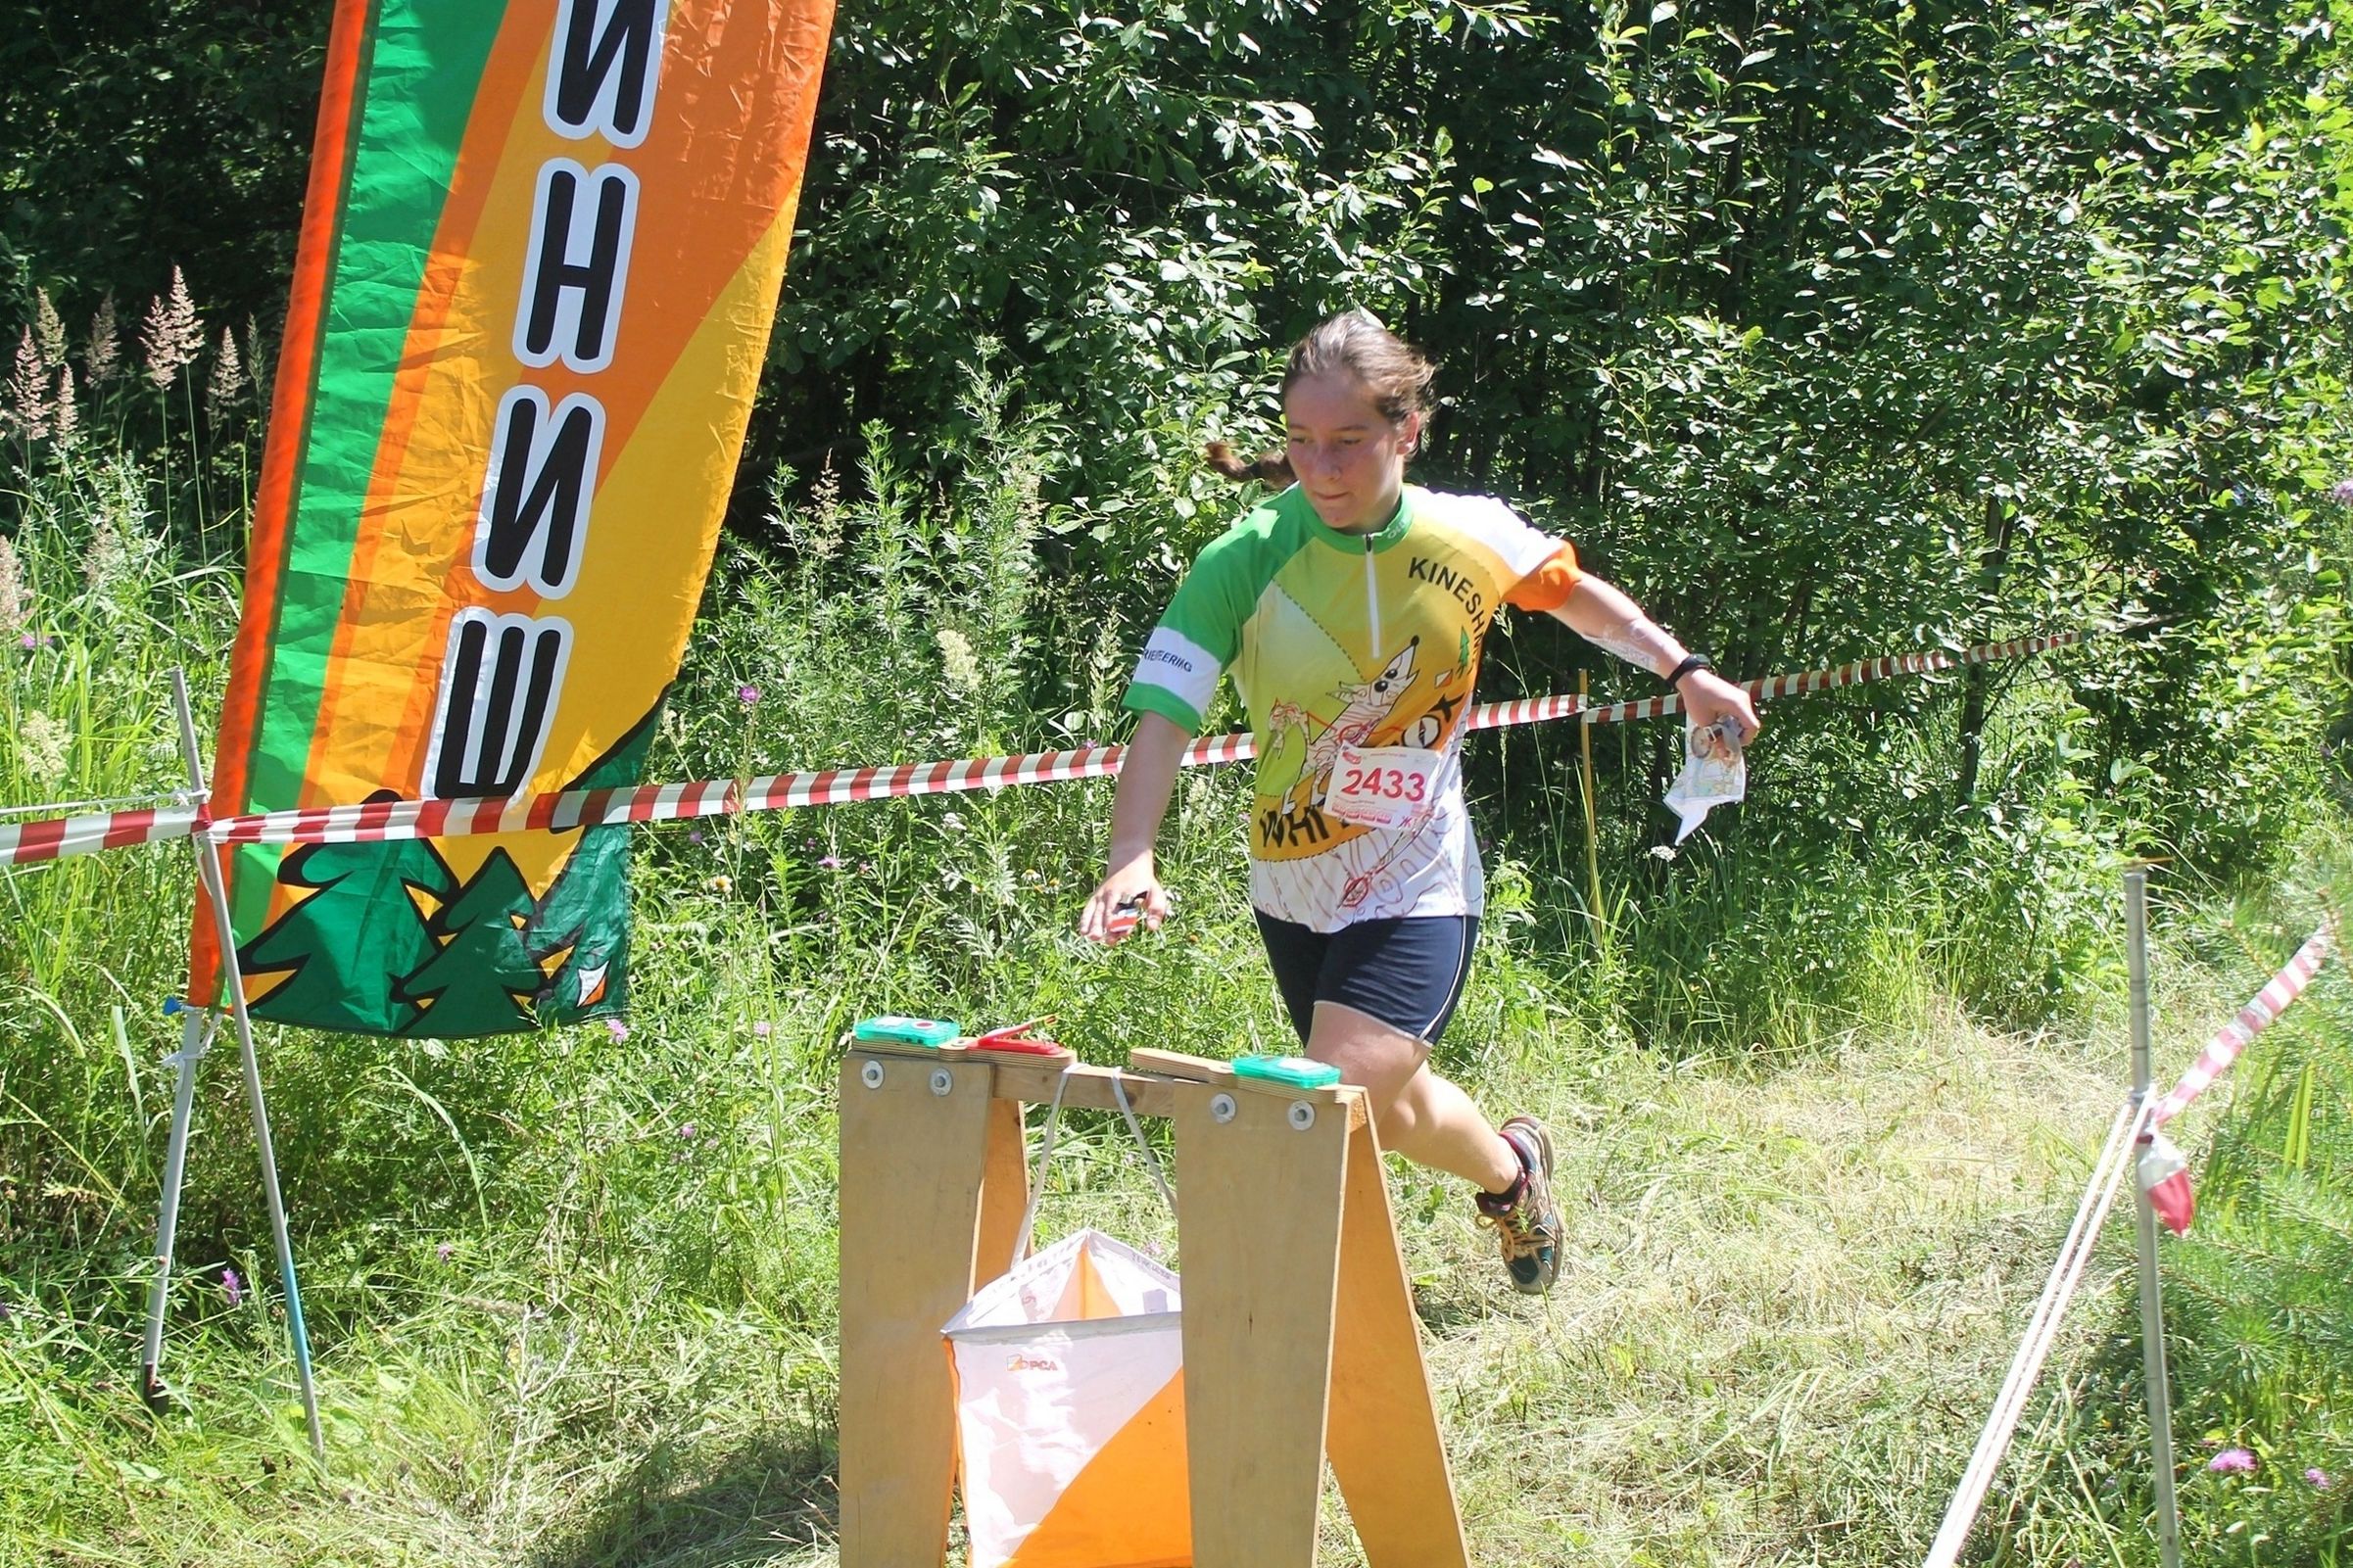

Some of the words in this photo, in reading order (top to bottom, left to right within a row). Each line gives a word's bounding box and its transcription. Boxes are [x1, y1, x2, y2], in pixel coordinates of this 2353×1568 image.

[1409, 556, 1485, 675] KINESHM
[1259, 805, 1350, 849] WHI
[1384, 692, 1466, 748] OX
[1340, 767, 1426, 802] 2433
